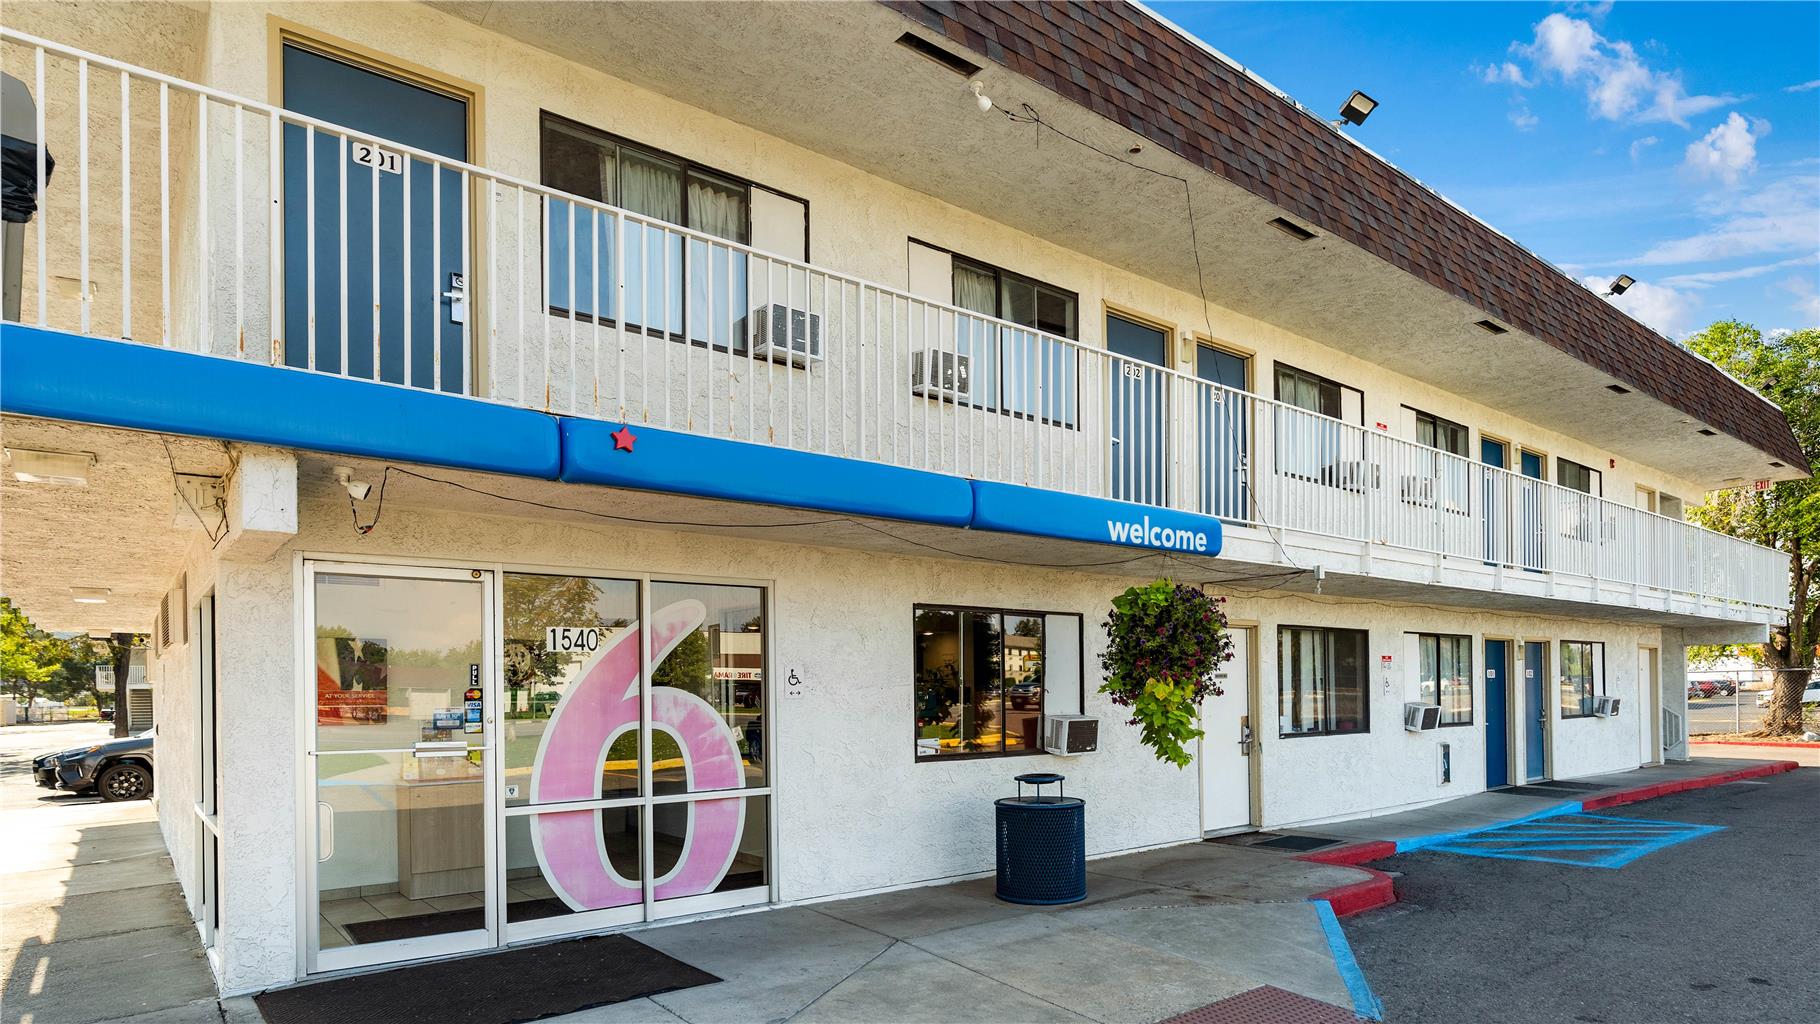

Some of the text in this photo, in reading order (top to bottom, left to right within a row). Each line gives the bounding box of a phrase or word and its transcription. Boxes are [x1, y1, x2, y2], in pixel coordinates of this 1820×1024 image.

[1755, 480, 1770, 490] EXIT
[1107, 515, 1208, 552] welcome
[550, 628, 599, 652] 1540
[529, 599, 746, 912] 6
